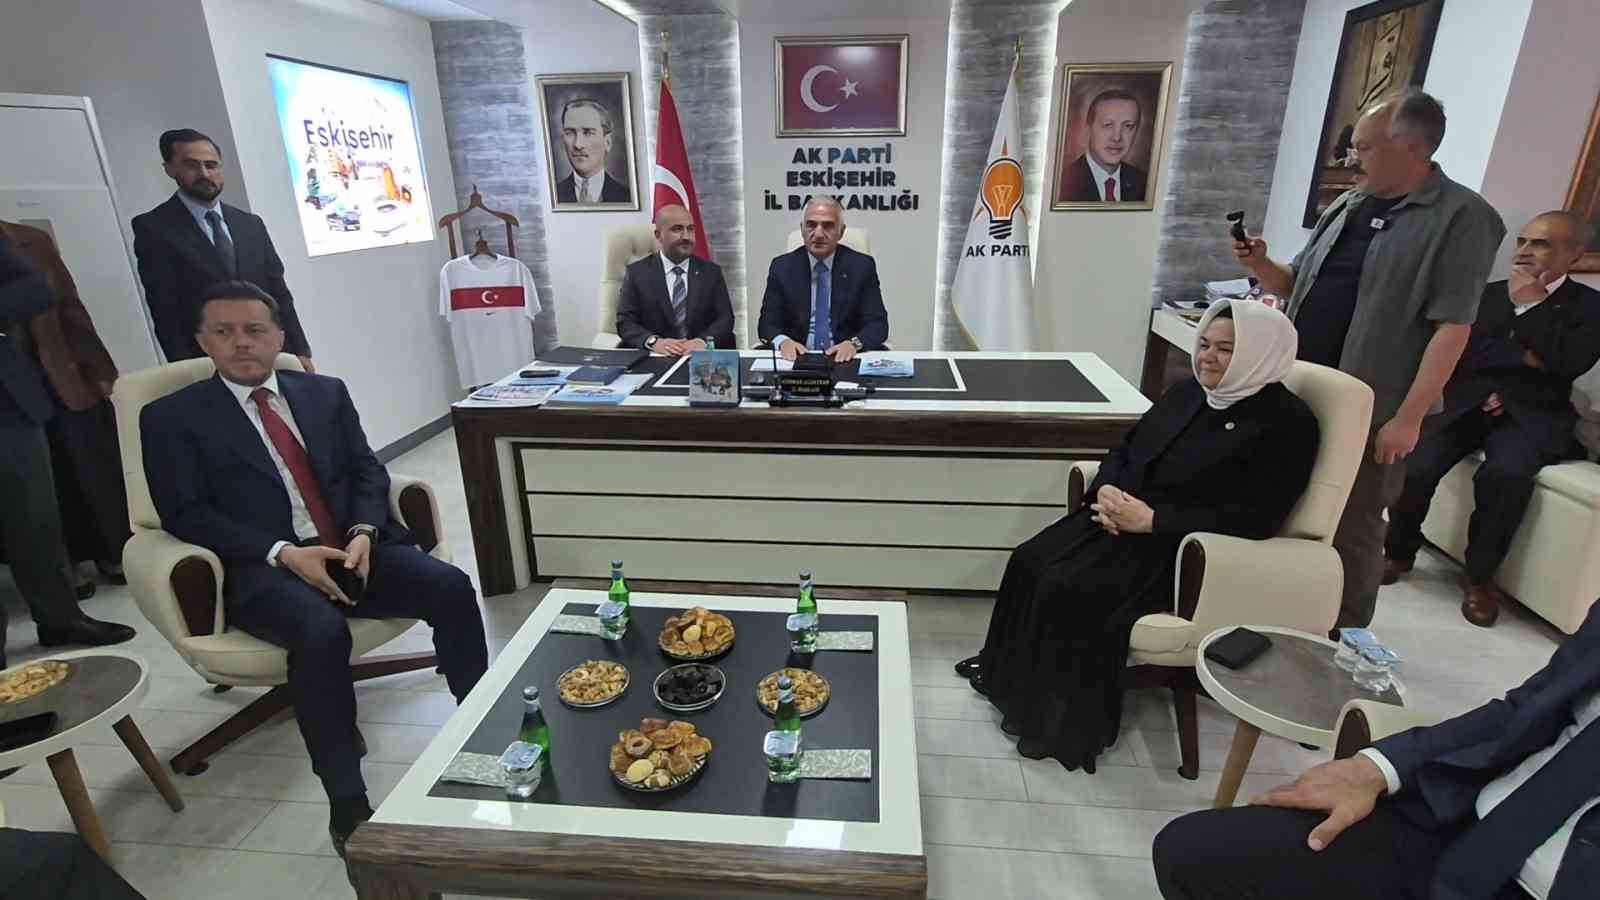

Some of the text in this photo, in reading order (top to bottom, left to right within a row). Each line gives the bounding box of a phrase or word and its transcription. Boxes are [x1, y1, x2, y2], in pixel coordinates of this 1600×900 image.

[791, 143, 892, 164] AK PARTİ
[786, 167, 897, 190] ESKİŞEHİR
[764, 189, 919, 211] İL BAKANLIĞI
[966, 244, 985, 257] AK
